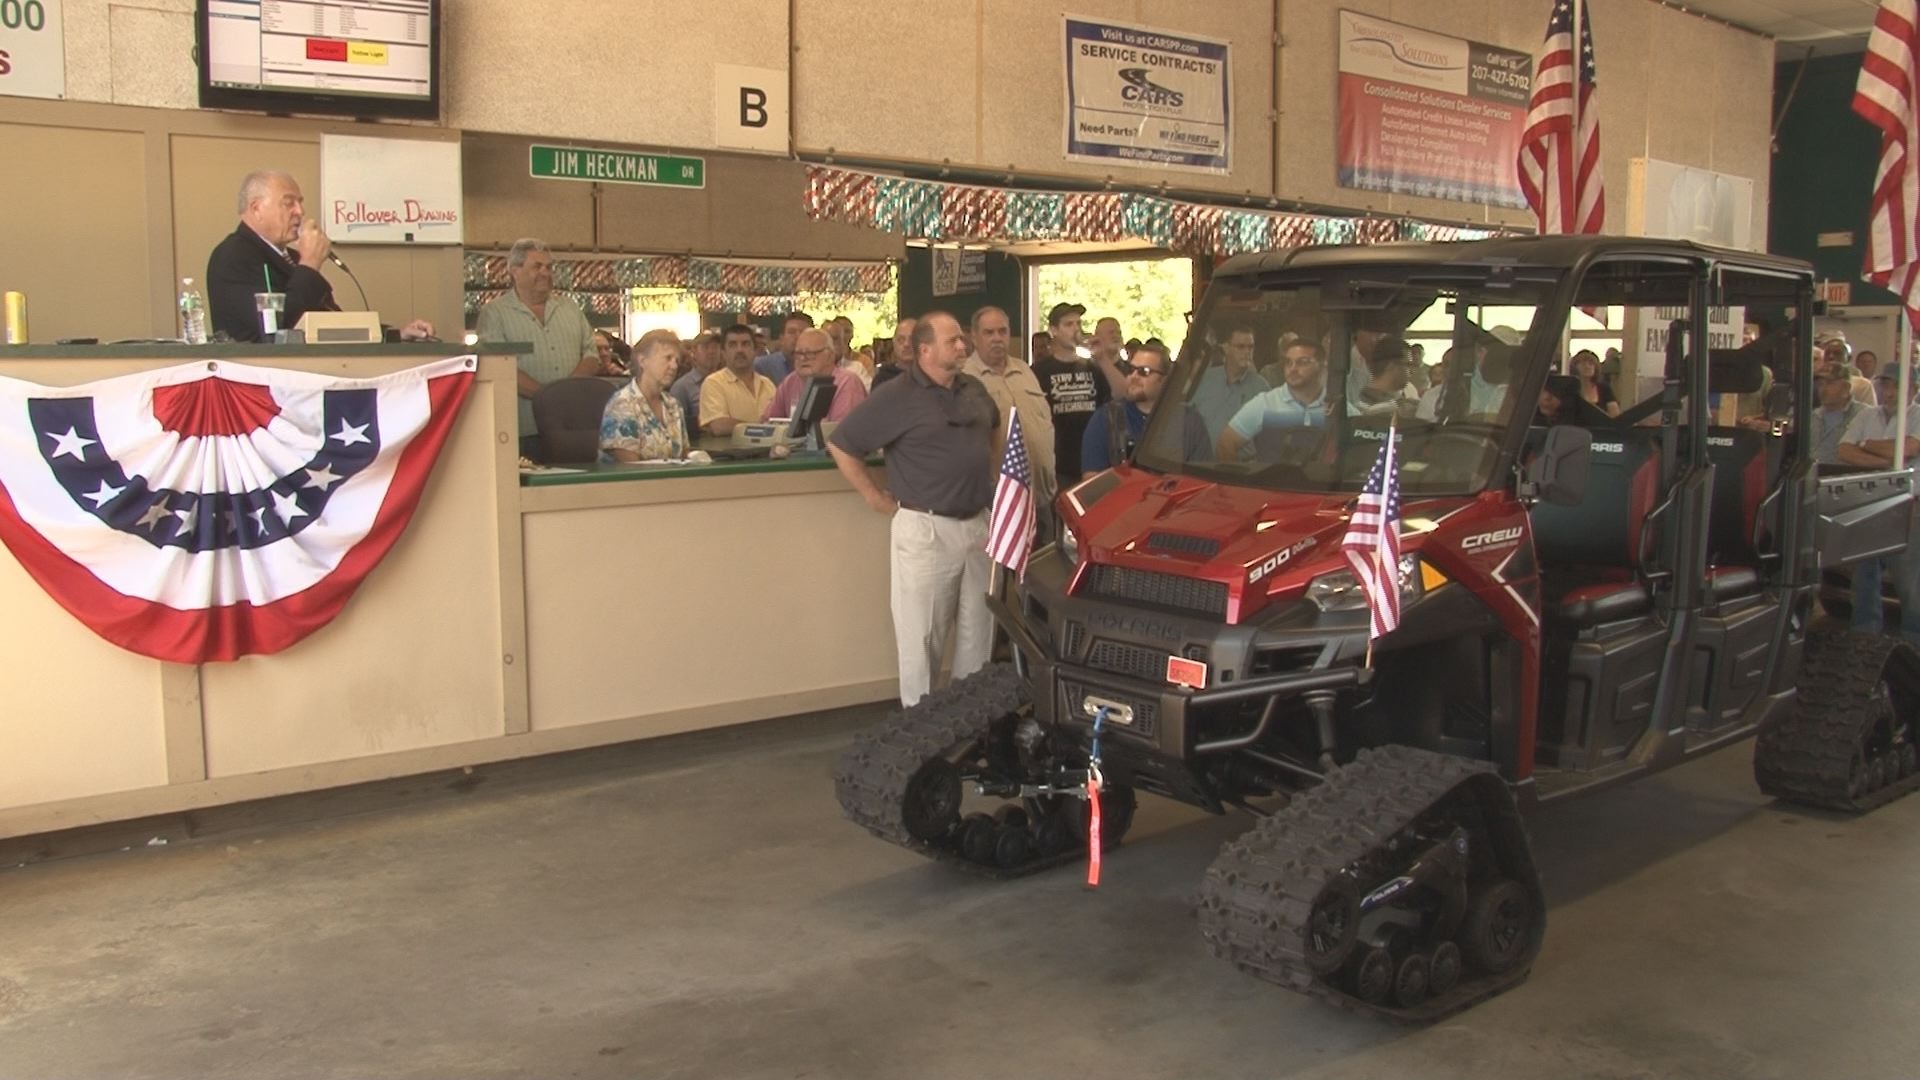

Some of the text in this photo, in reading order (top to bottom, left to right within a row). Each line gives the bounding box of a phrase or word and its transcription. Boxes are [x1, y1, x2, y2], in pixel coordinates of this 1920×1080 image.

[1101, 28, 1122, 41] Visit
[1125, 34, 1135, 44] us
[1136, 36, 1146, 46] at
[1081, 44, 1216, 75] SERVICE CONTRACTS!
[1471, 65, 1529, 90] 207-427-6702
[739, 86, 768, 128] B
[1121, 85, 1184, 107] CARS
[1364, 82, 1418, 102] Consolidated
[1483, 105, 1512, 121] Services
[1080, 123, 1138, 137] Need Parts?
[552, 151, 694, 181] JIM HECKMAN DR
[1646, 328, 1670, 353] FAM
[1590, 442, 1624, 453] ARIS
[1461, 525, 1523, 549] CREW
[1248, 548, 1290, 584] 900
